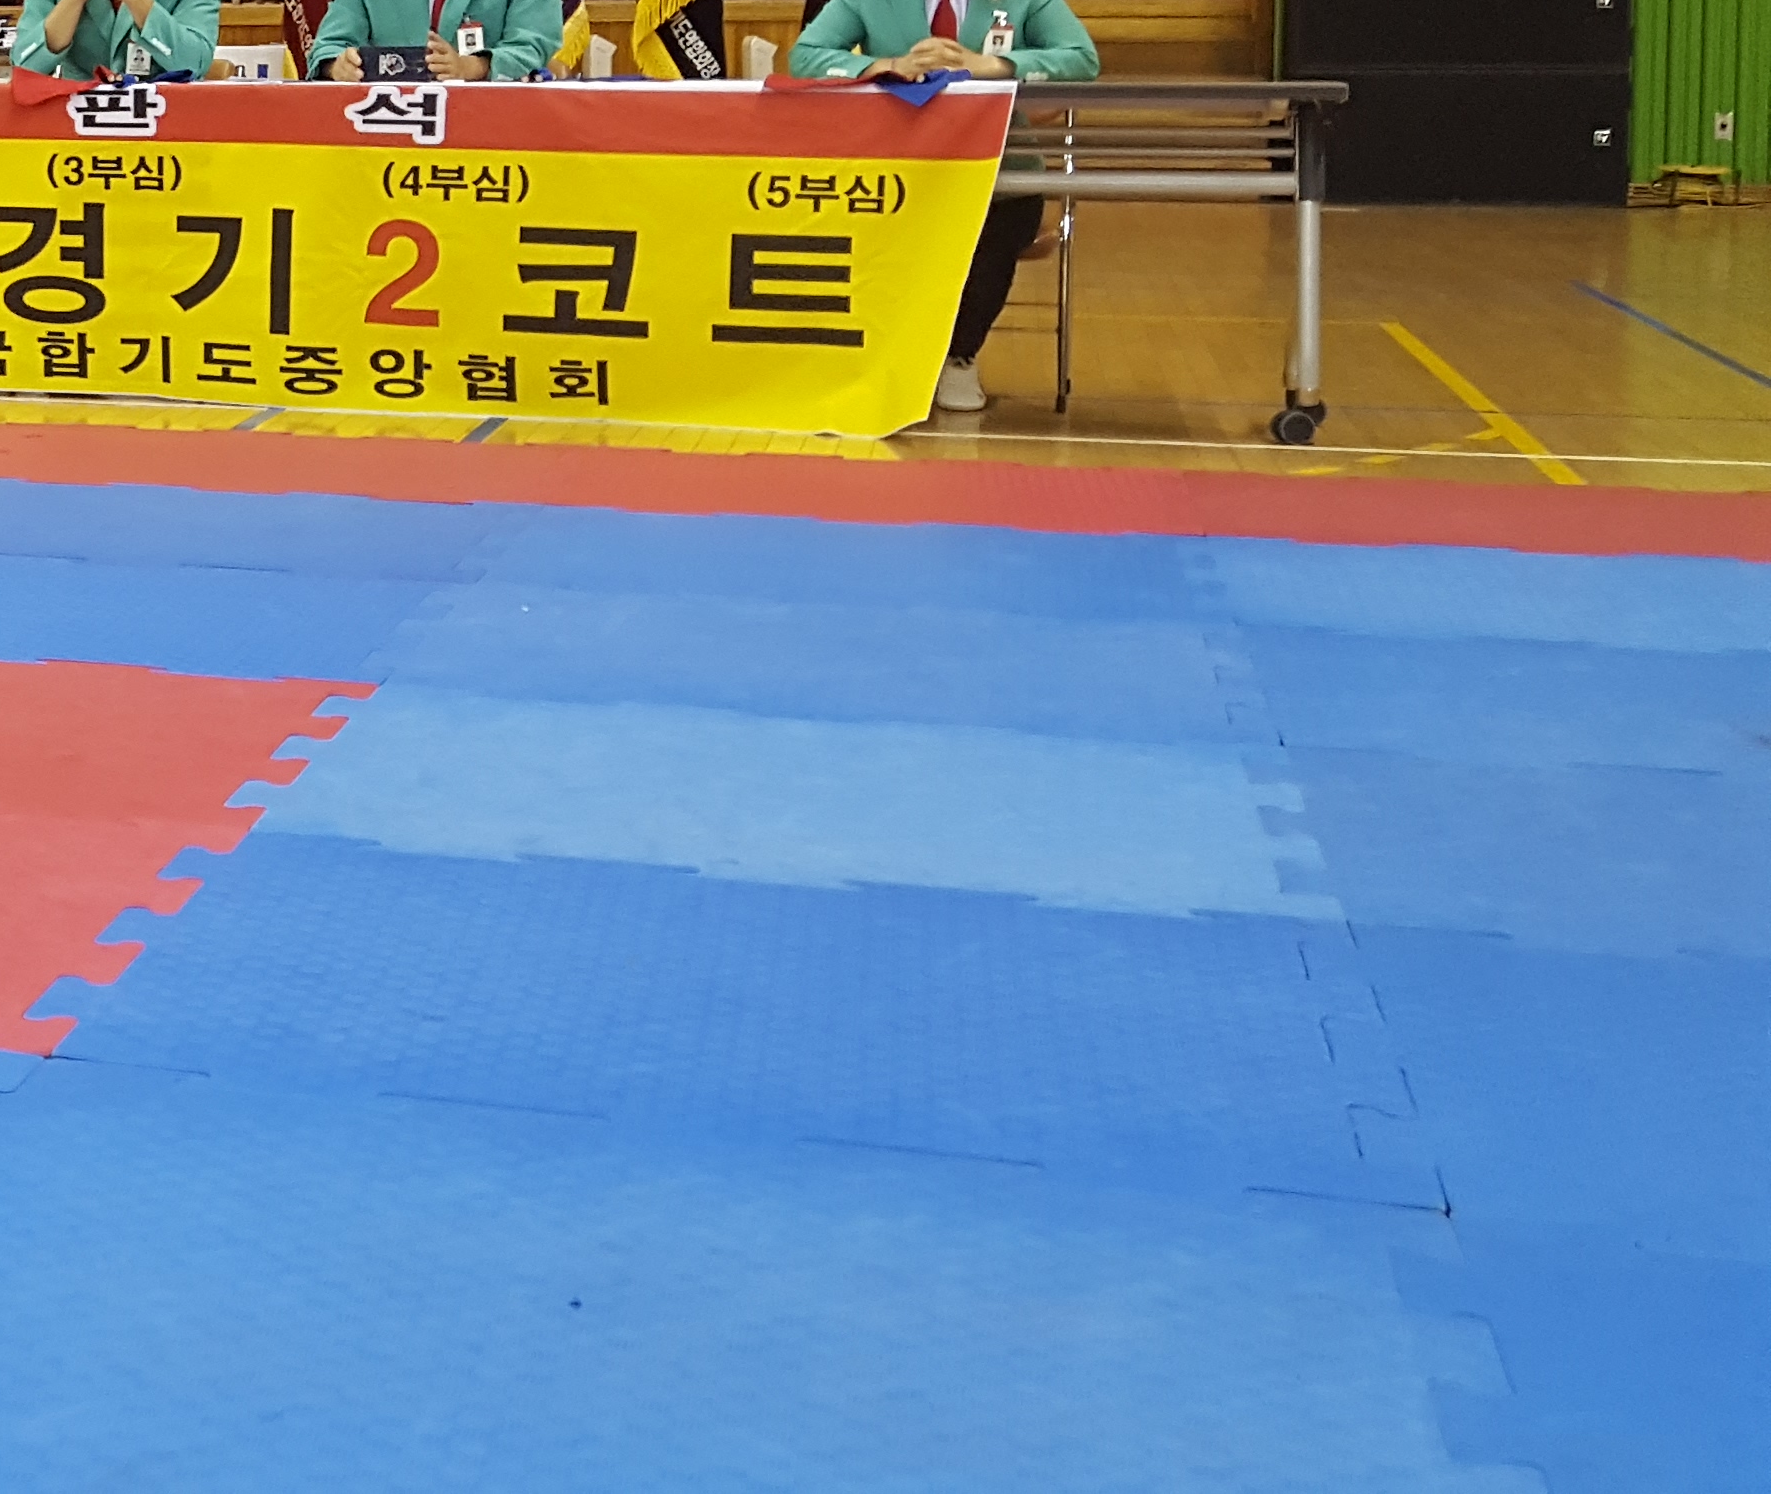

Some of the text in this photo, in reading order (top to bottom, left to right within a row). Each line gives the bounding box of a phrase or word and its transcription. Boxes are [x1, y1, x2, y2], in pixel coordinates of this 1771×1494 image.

[46, 153, 184, 194] (3부심)
[381, 161, 531, 205] (4부심)
[746, 170, 908, 215] (5부심)
